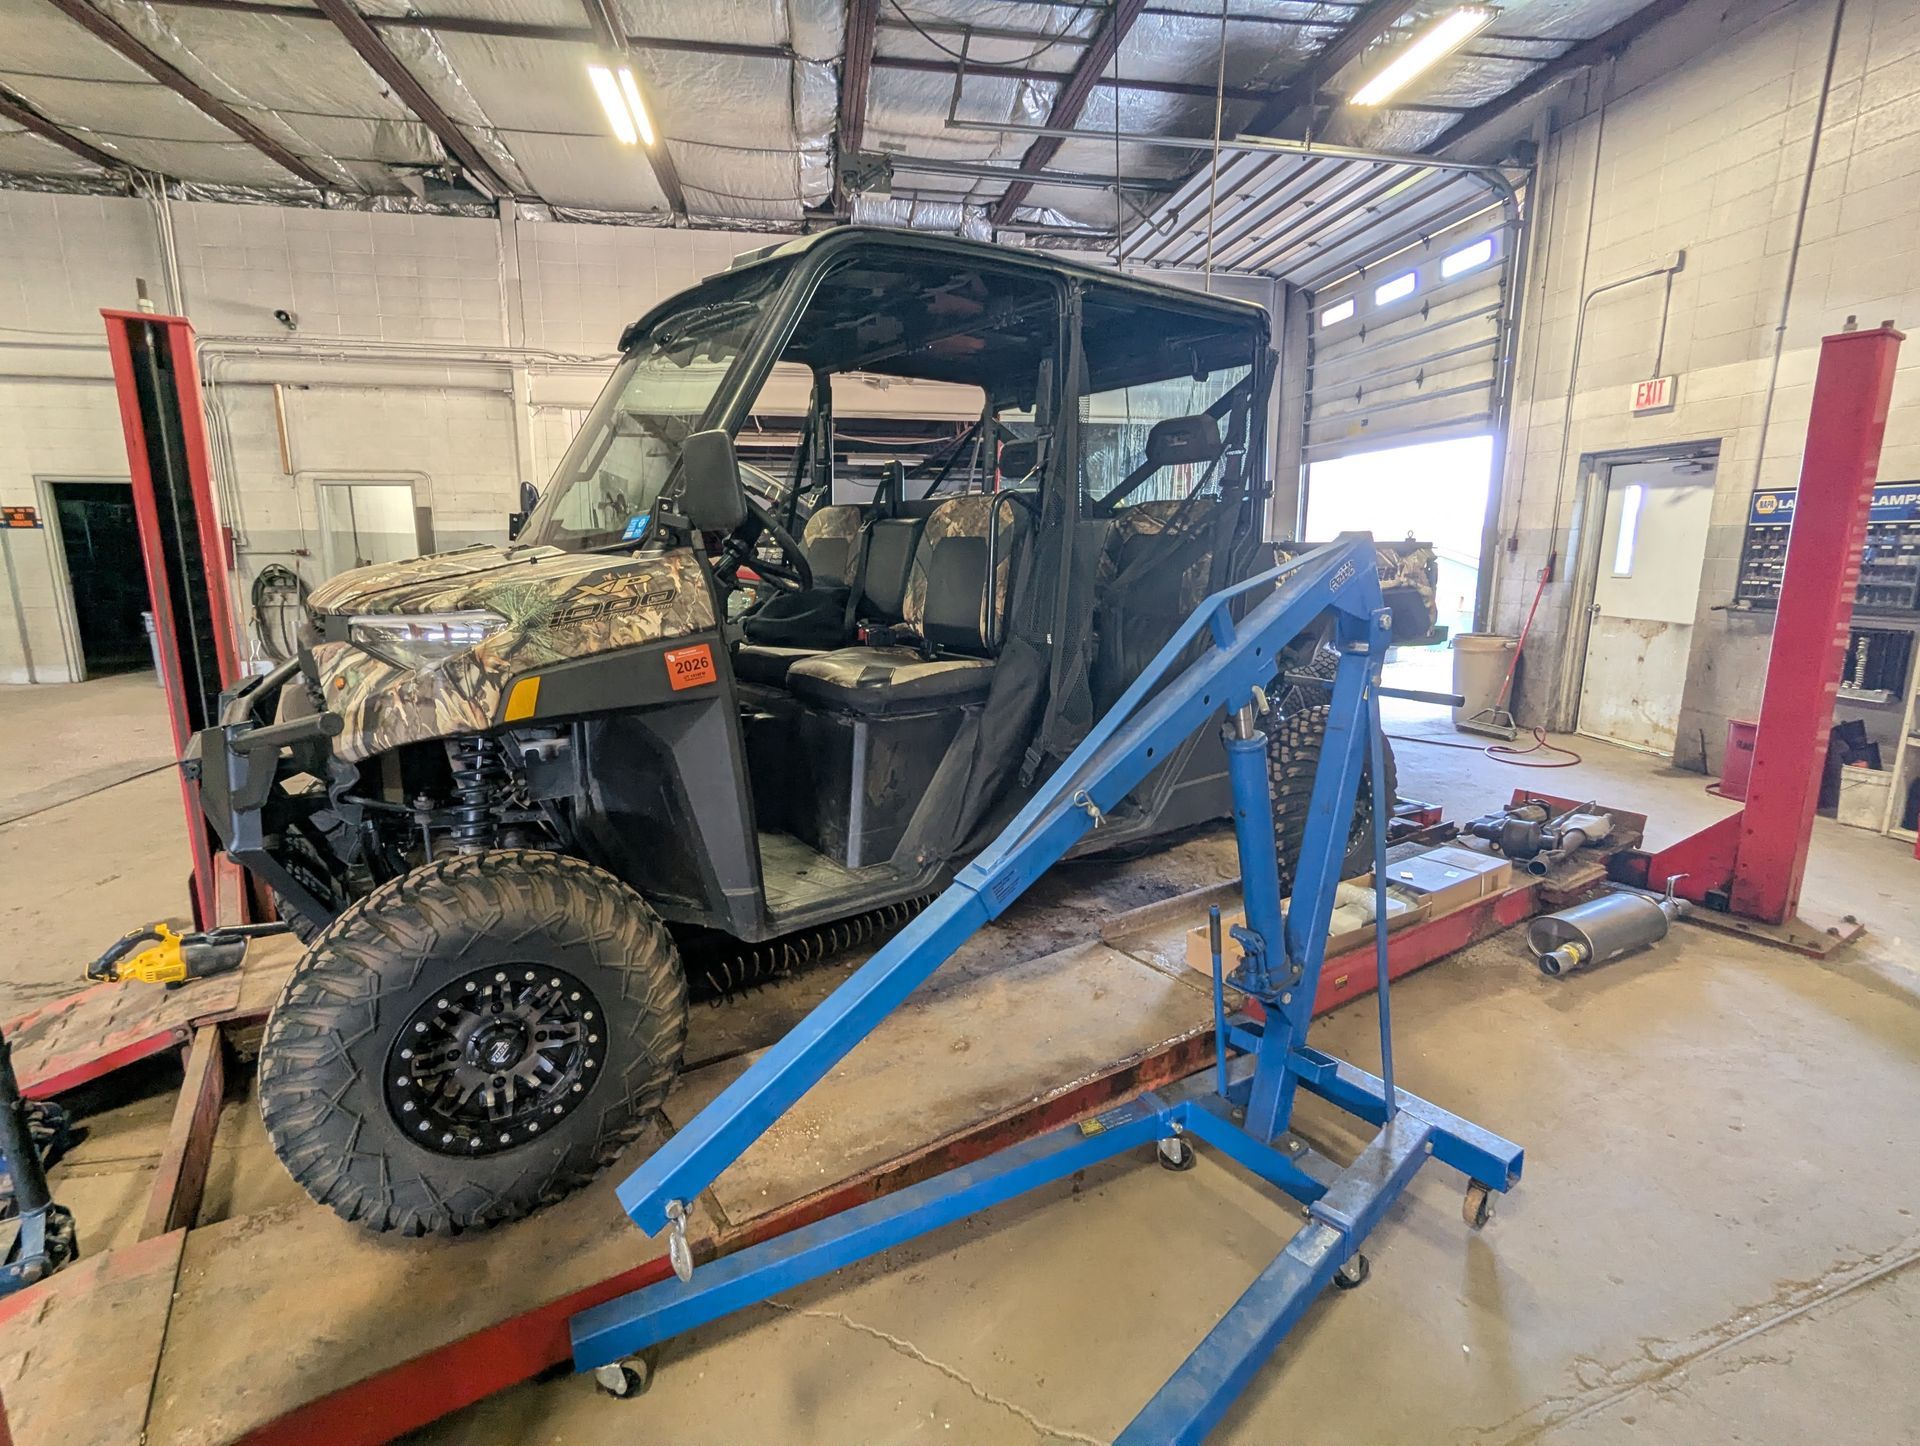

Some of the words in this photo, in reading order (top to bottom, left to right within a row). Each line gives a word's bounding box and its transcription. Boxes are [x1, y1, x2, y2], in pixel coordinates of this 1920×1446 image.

[1636, 379, 1665, 408] EXIT
[1778, 499, 1794, 509] LA
[563, 574, 652, 602] XP
[549, 588, 677, 627] 1000
[675, 656, 709, 675] 2026
